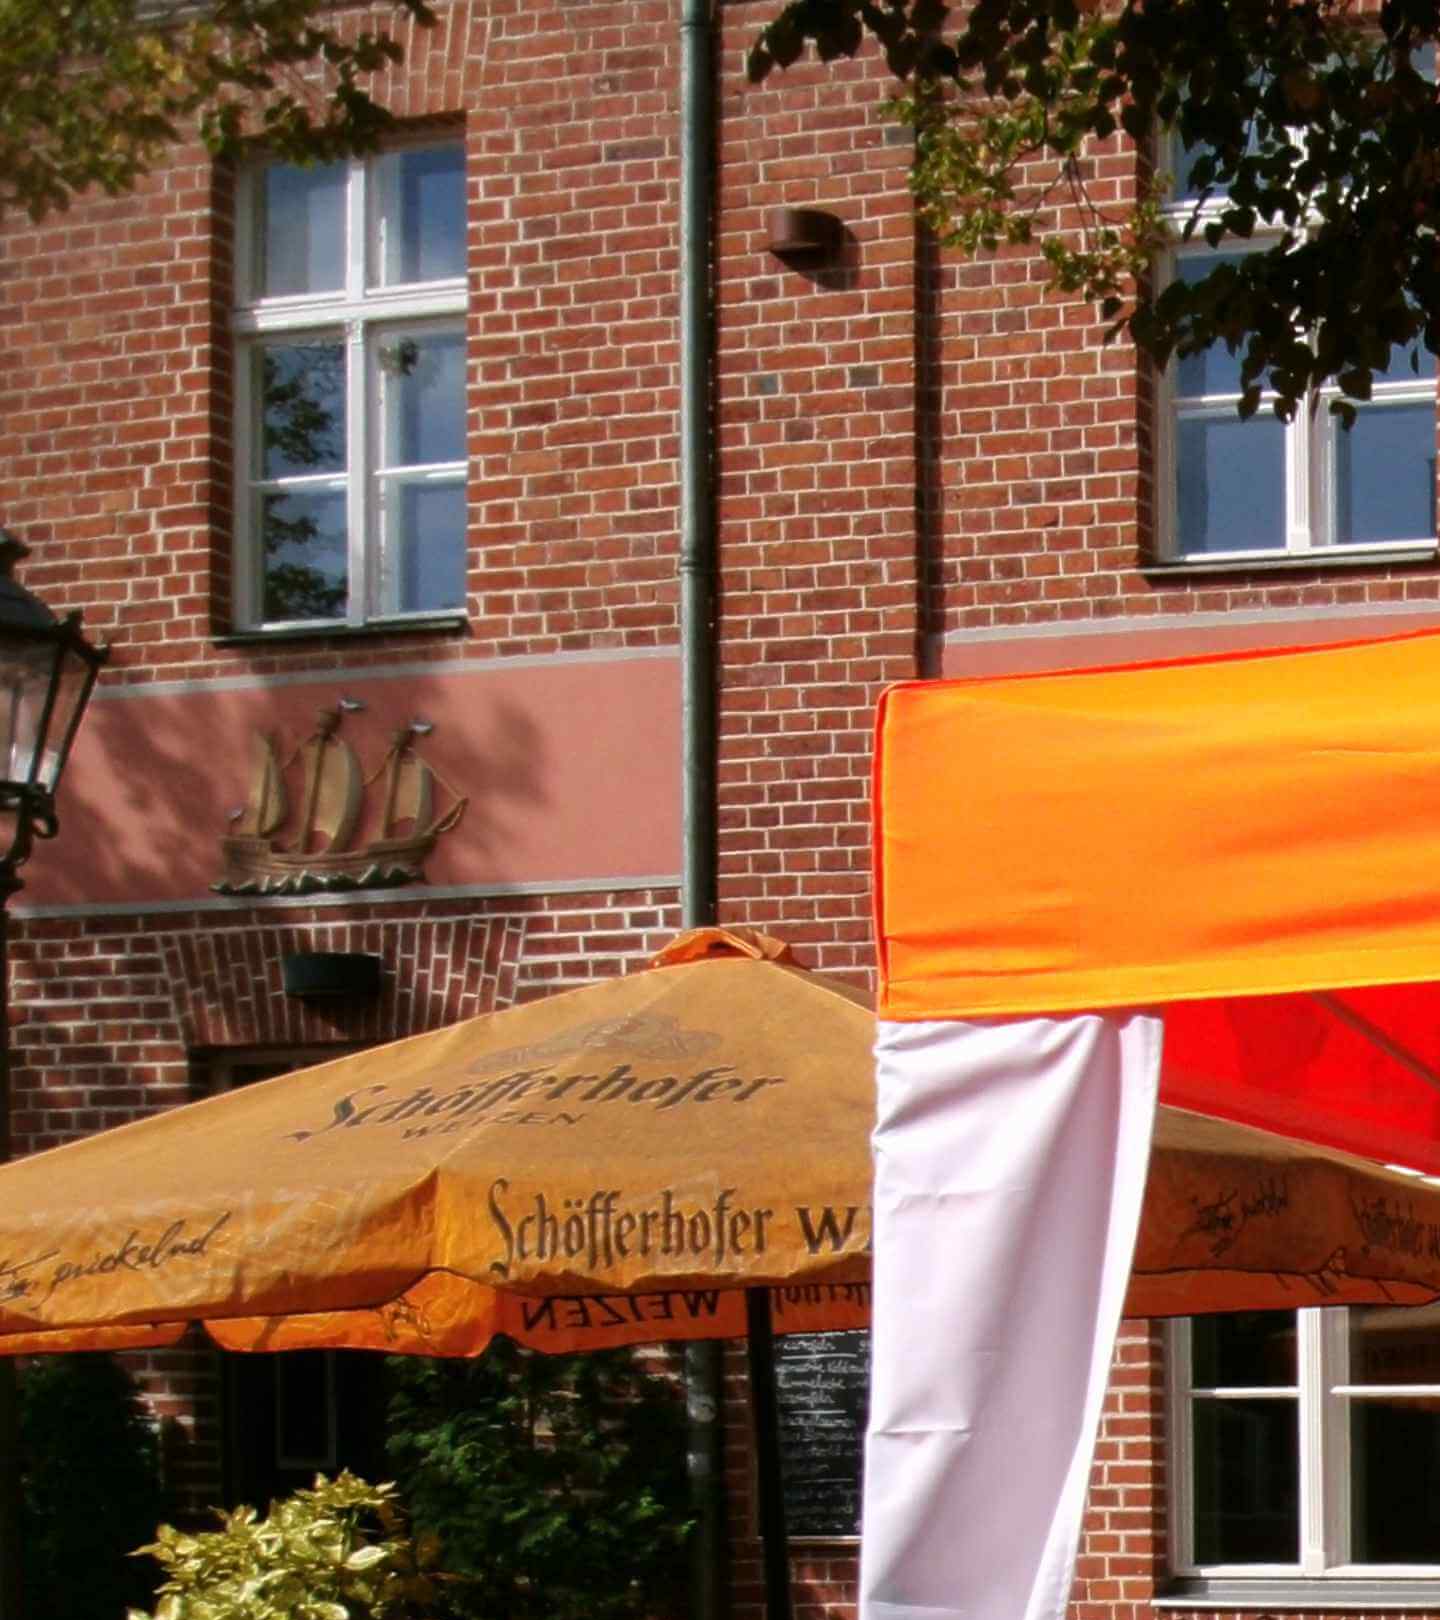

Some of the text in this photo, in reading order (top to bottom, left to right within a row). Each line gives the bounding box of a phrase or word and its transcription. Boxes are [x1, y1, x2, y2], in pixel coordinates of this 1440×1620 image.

[284, 1065, 786, 1141] Schöfferhofer
[402, 1111, 587, 1140] WEIZEN
[487, 1178, 773, 1281] Schöfferhofer
